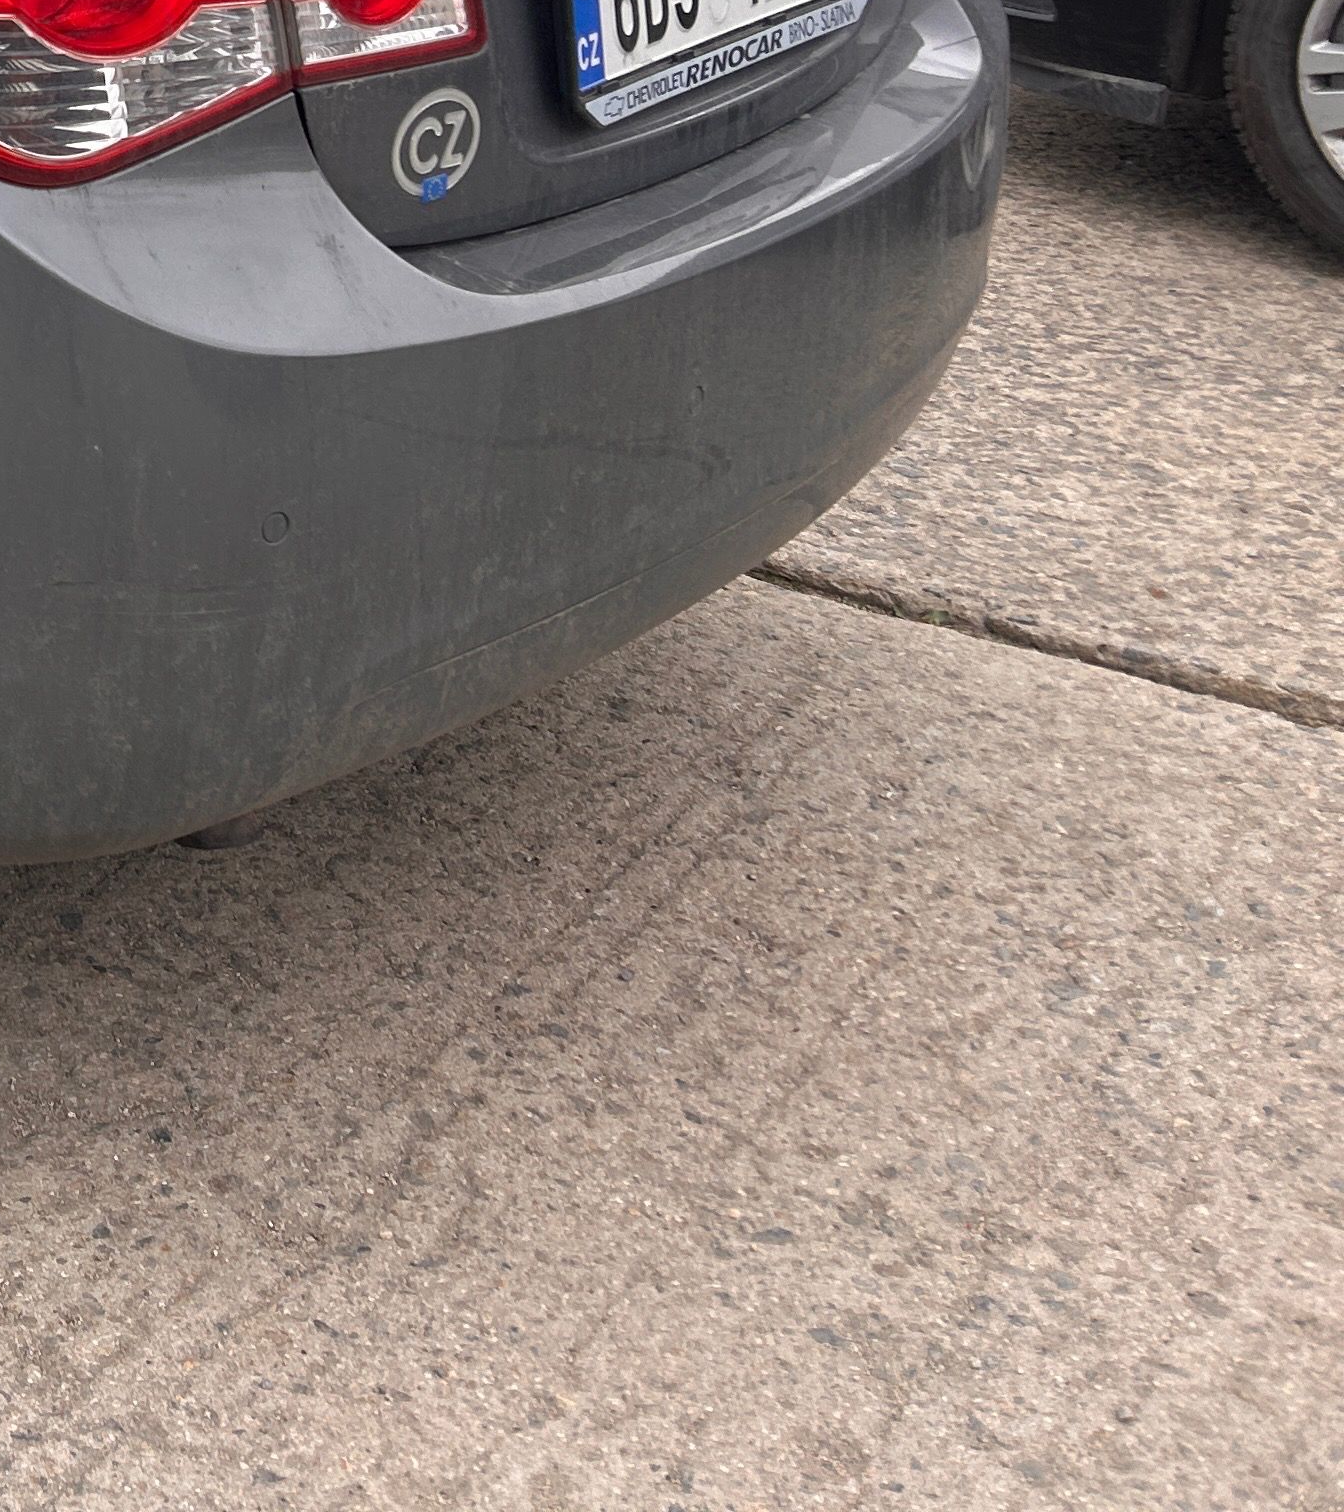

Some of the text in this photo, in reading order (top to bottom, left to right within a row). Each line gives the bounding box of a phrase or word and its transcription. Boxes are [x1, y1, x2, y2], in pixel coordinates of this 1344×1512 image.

[577, 33, 602, 71] CZ
[627, 71, 686, 109] CHEVROLET
[685, 29, 782, 88] RENOCAR
[821, 2, 856, 32] SLATINA
[409, 110, 467, 174] CZ
